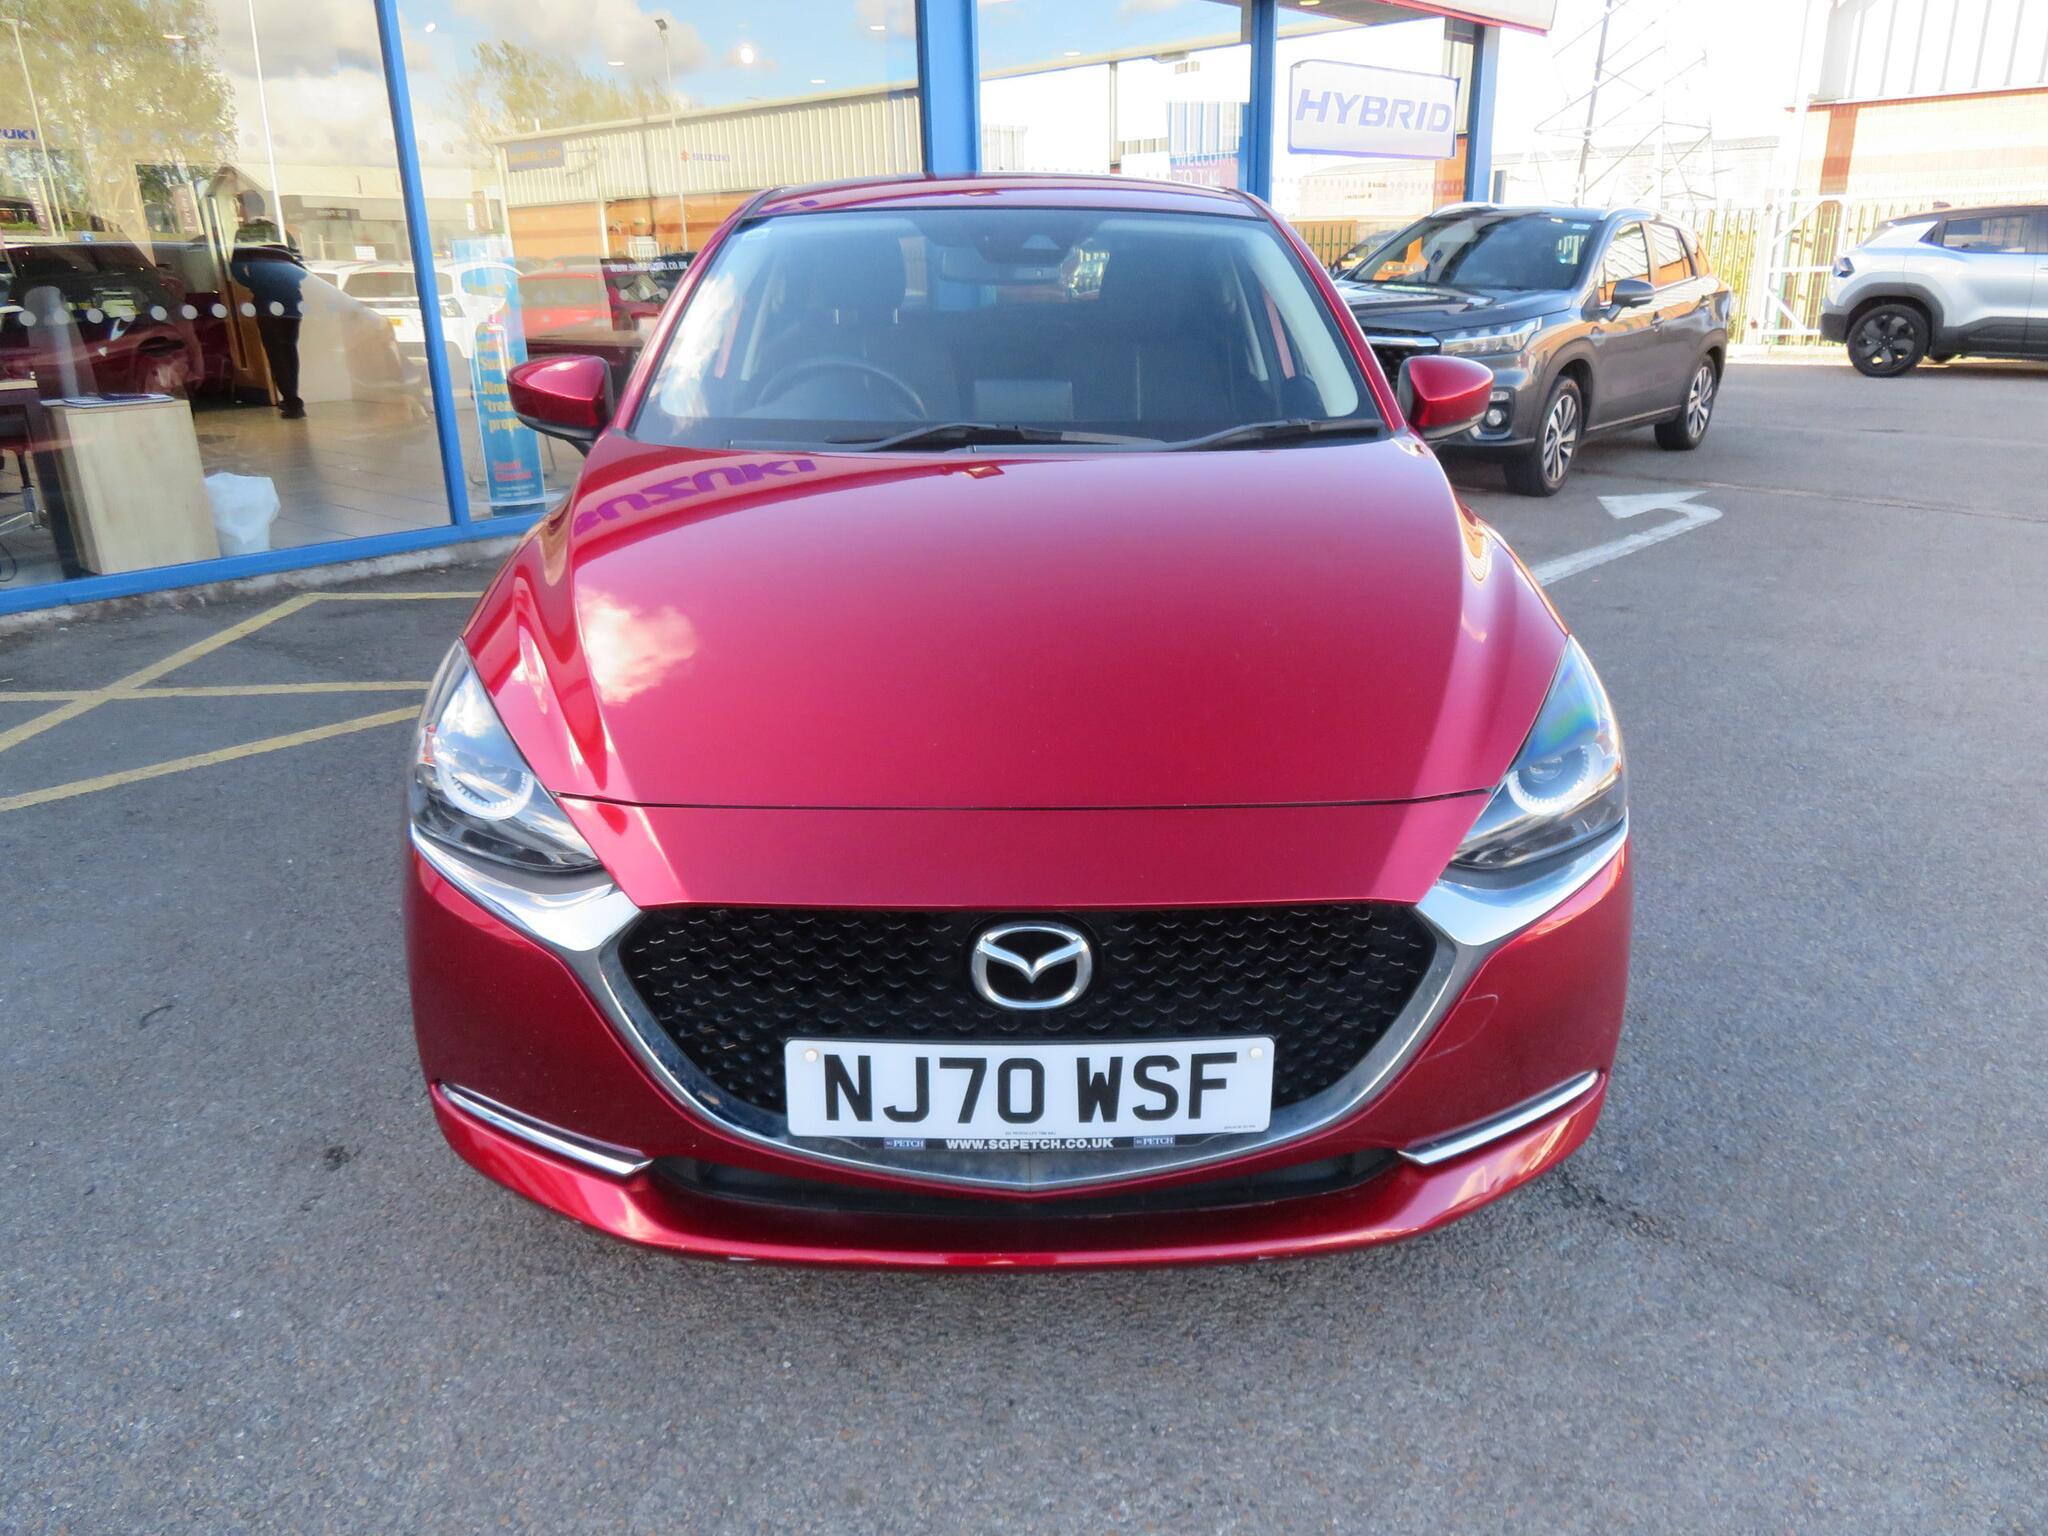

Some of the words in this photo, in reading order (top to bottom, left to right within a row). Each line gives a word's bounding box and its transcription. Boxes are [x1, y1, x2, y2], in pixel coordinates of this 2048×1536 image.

[1295, 88, 1452, 133] HYBRID
[0, 128, 36, 140] UKI
[692, 152, 731, 162] SUZUKI
[824, 1054, 1045, 1124] NJ70
[1076, 1052, 1238, 1123] WSF
[893, 1139, 924, 1148] PETCH
[946, 1138, 1114, 1150] WWW.SGPETCH.CO.UK
